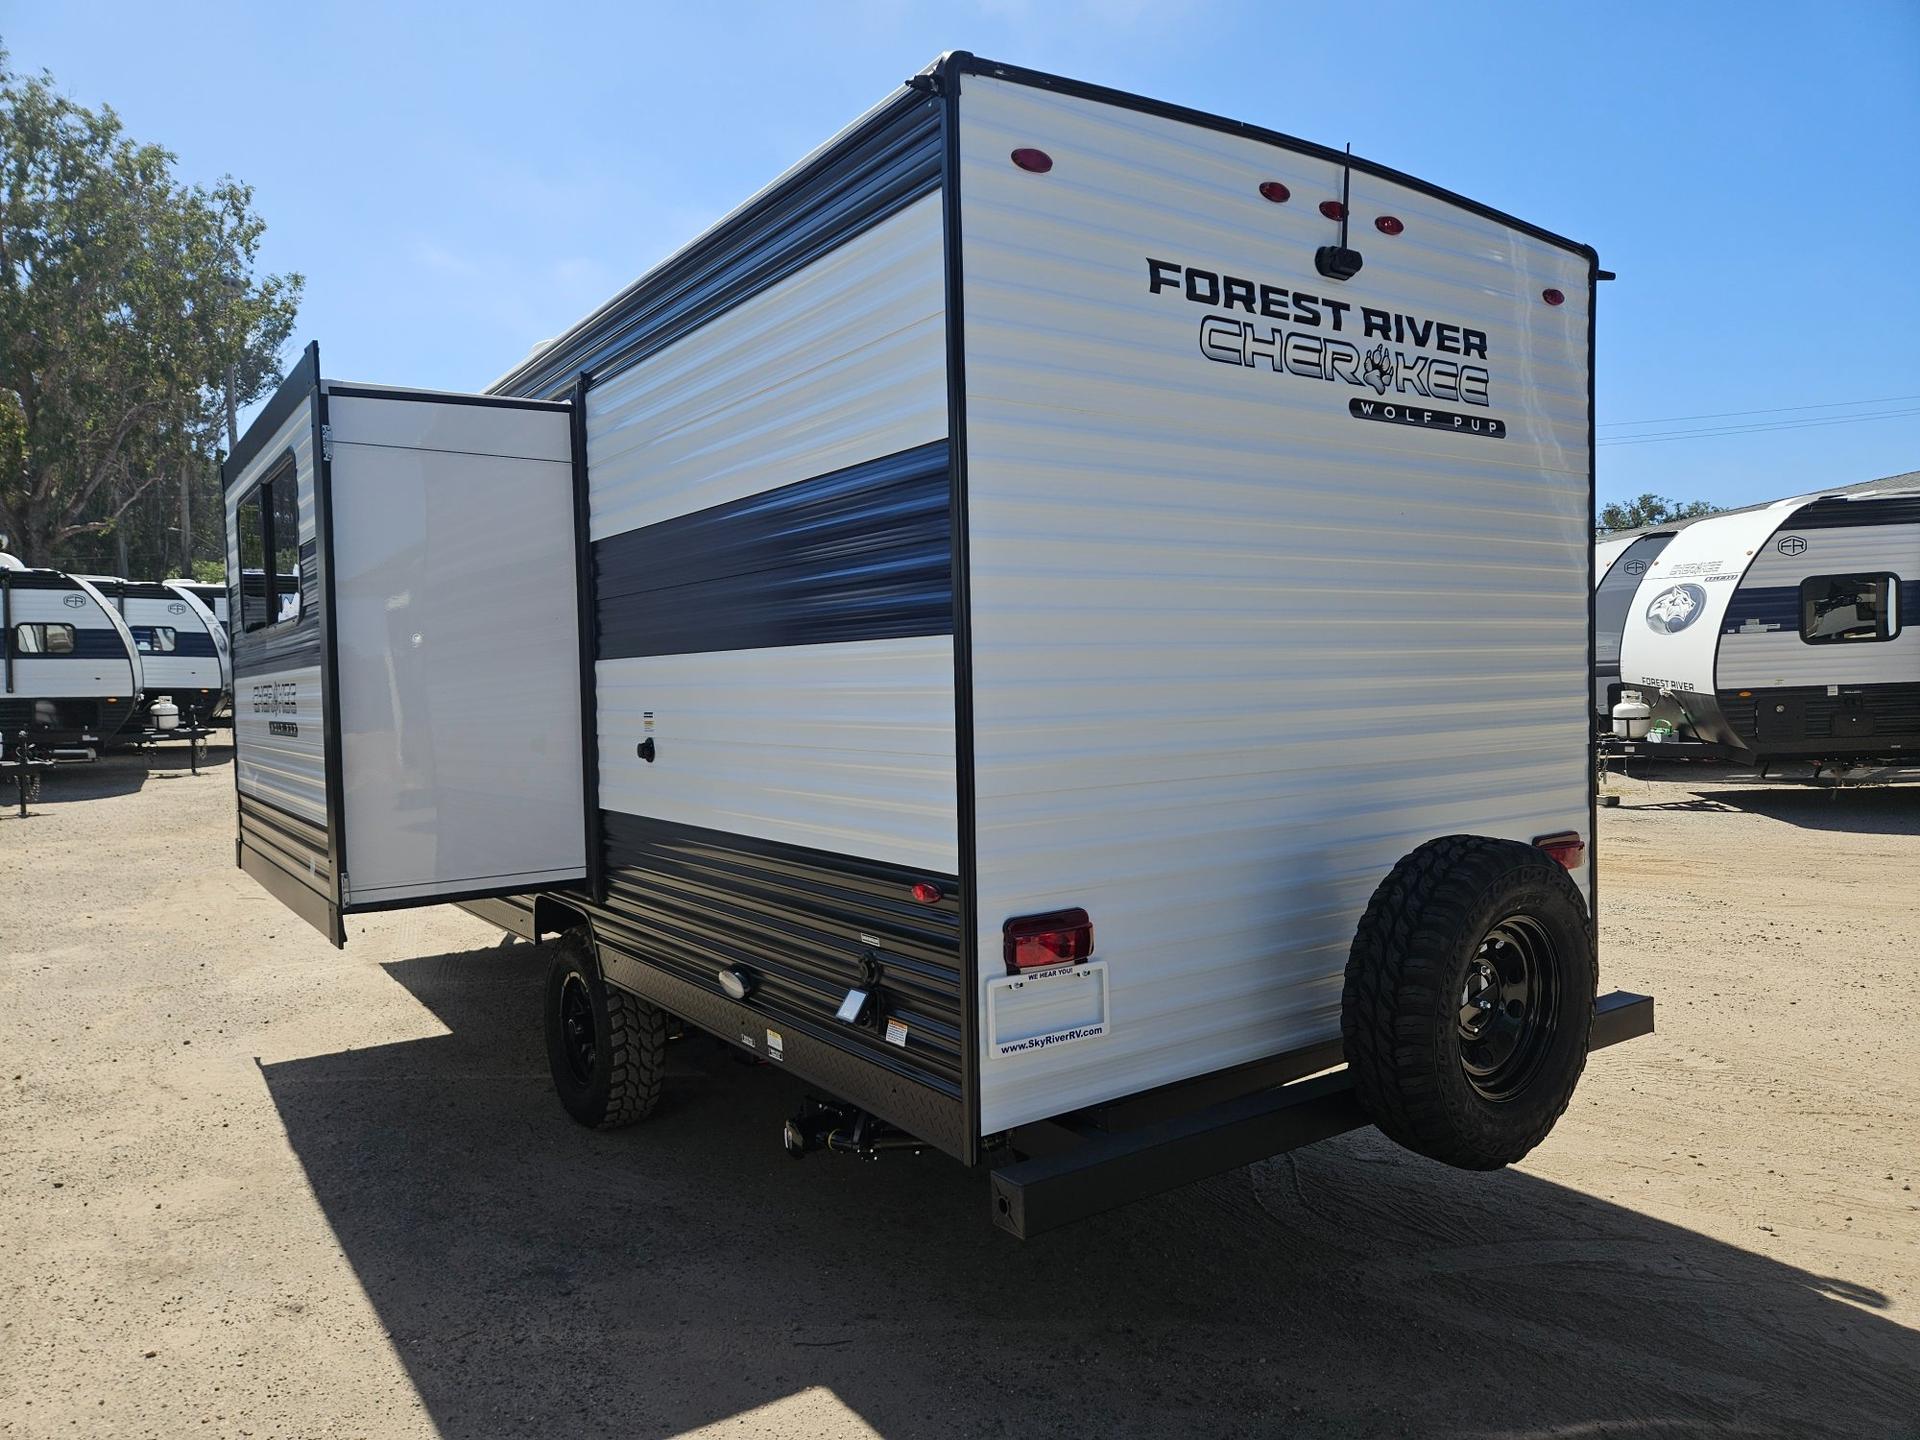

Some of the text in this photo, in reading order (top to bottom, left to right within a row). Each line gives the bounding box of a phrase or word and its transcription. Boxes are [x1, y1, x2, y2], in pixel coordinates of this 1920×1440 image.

[1146, 257, 1488, 360] FOREST RIVER
[1360, 401, 1497, 433] WOLF PUP
[1641, 676, 1695, 691] FOREST RIVER
[1028, 967, 1073, 981] WE HEAR YOU!
[1001, 1026, 1103, 1054] www.SkyRiverRV.com
